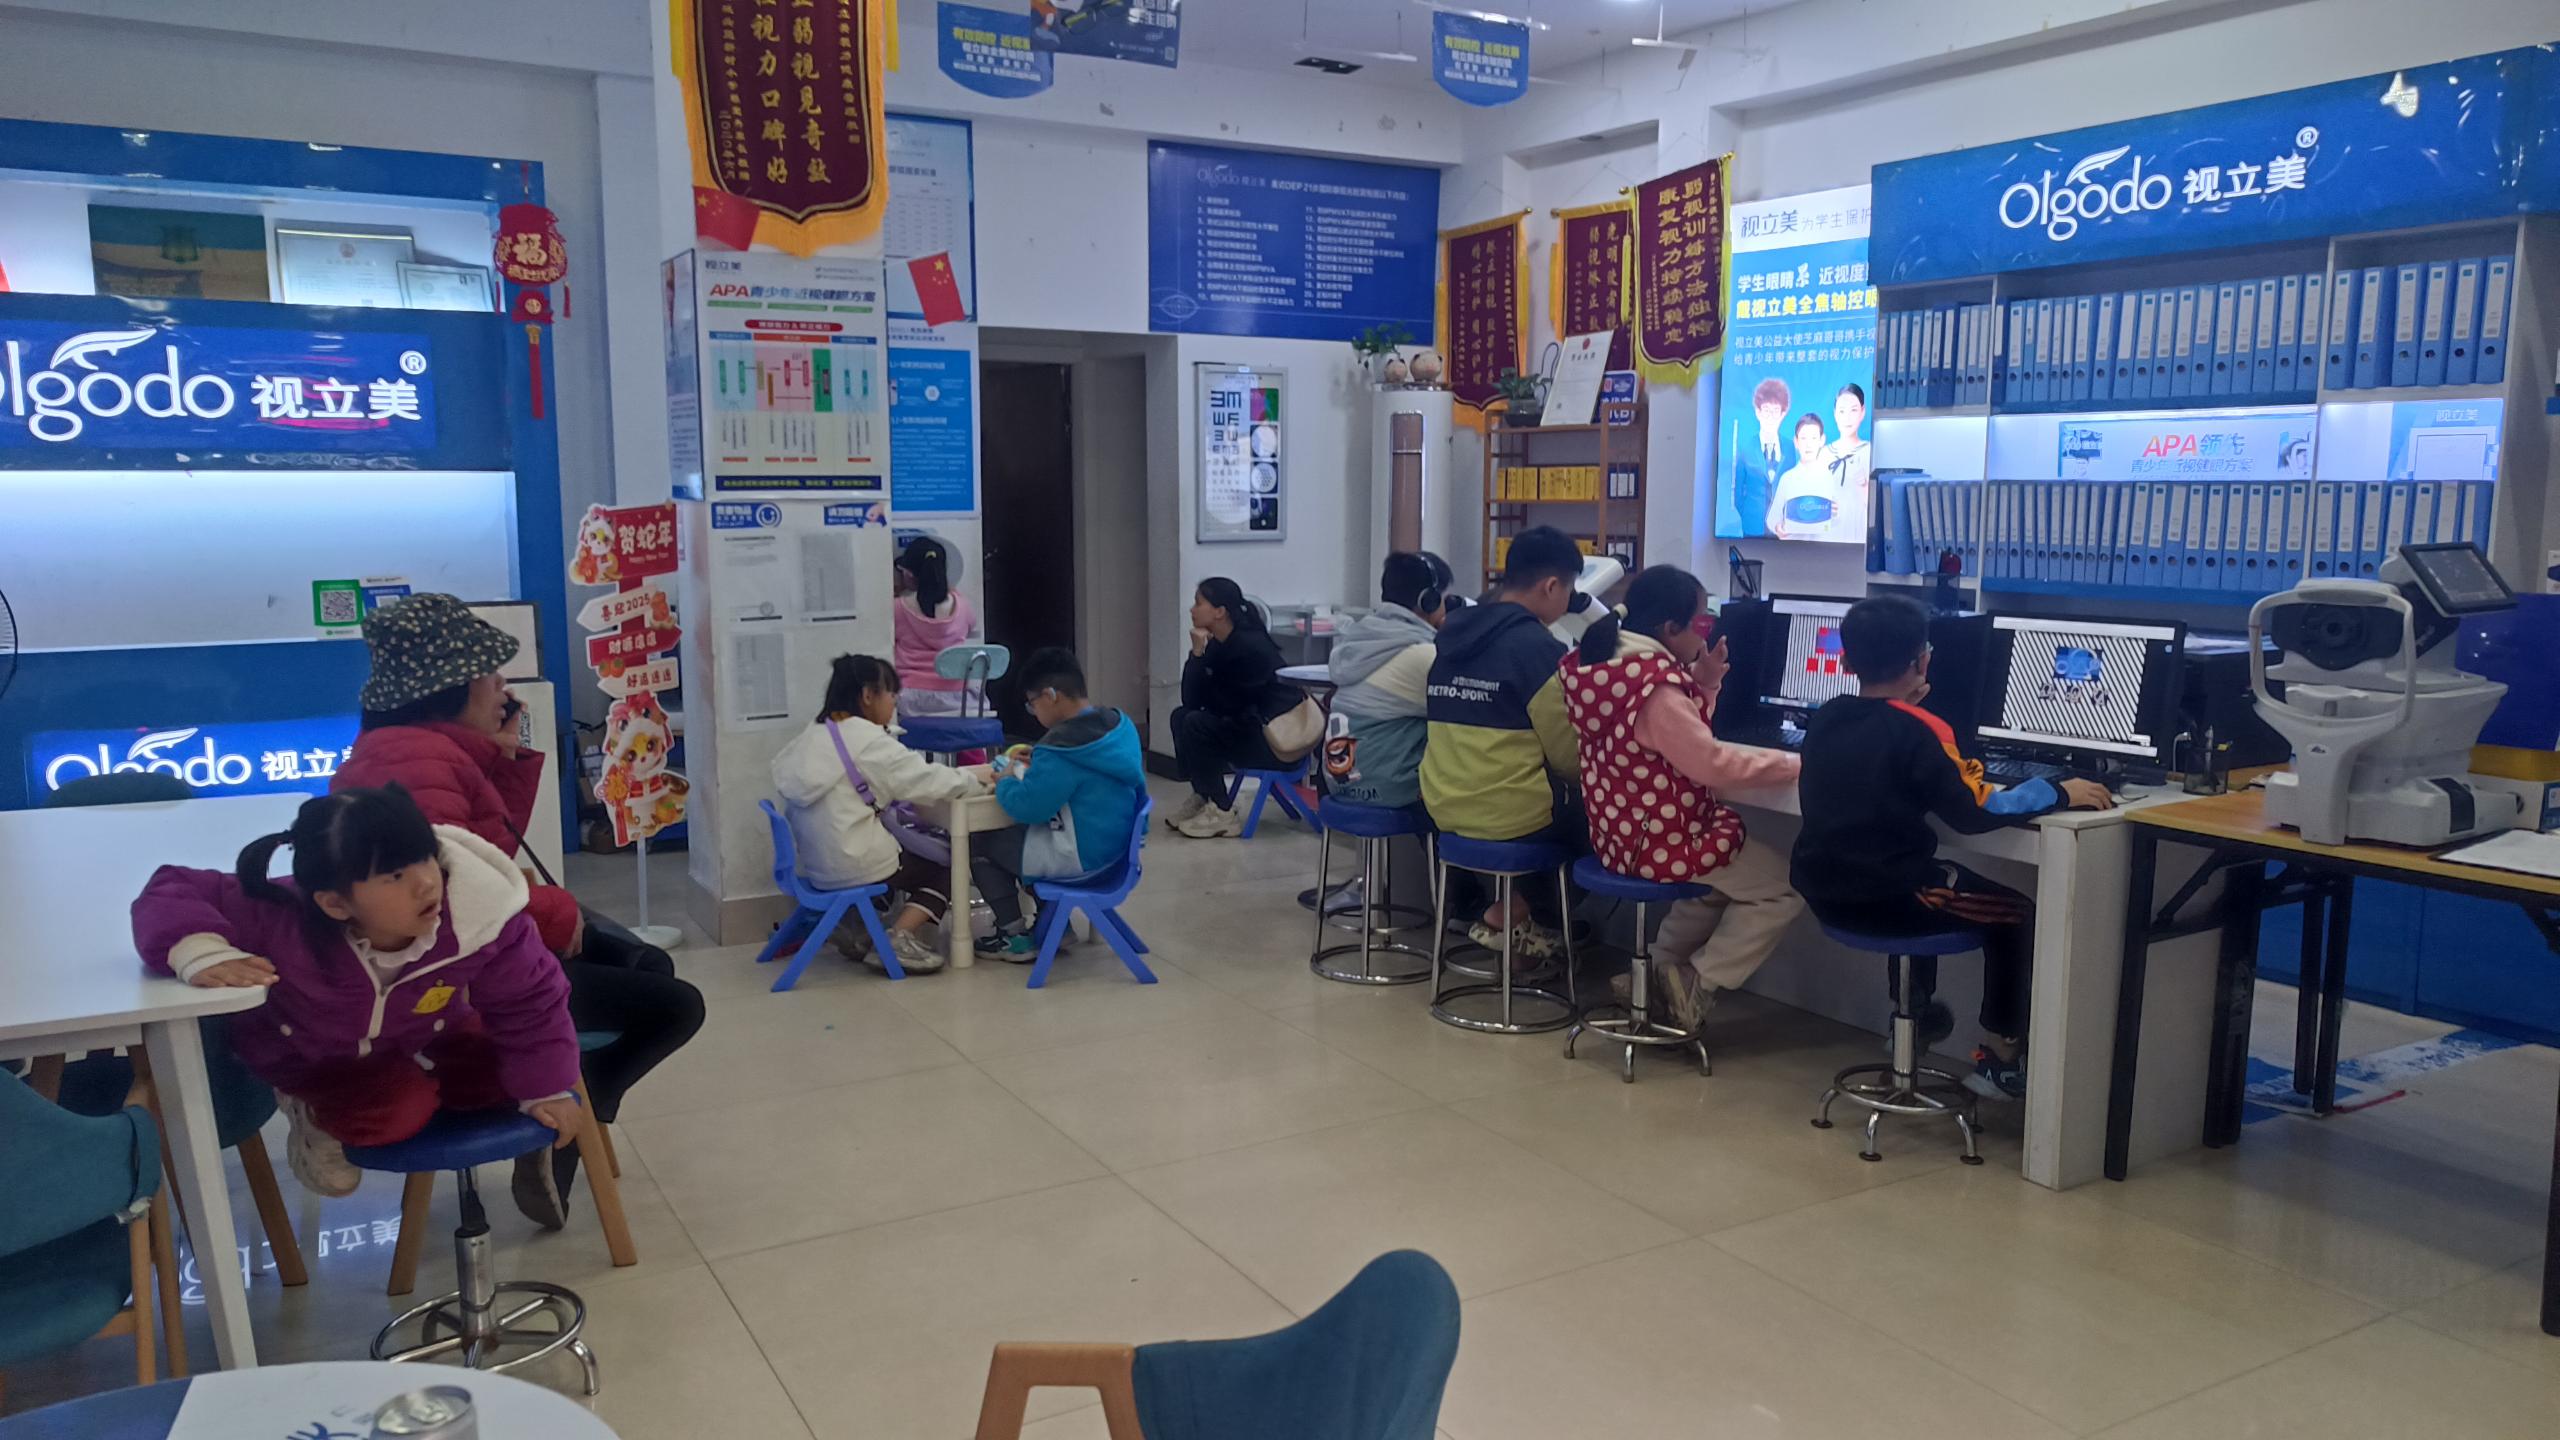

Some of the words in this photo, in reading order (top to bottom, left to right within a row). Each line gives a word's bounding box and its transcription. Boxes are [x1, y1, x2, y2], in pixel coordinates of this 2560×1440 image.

[750, 0, 788, 184] 視力口碑好
[1999, 155, 2172, 241] Olgodo
[2183, 152, 2306, 204] 视立美
[1741, 208, 1799, 238] 视立美
[512, 233, 548, 266] 福
[1819, 263, 1869, 287] 近视度
[0, 341, 235, 442] lgodo
[251, 374, 421, 420] 视立美
[618, 520, 673, 555] 贺蛇年
[261, 746, 352, 781] 视立
